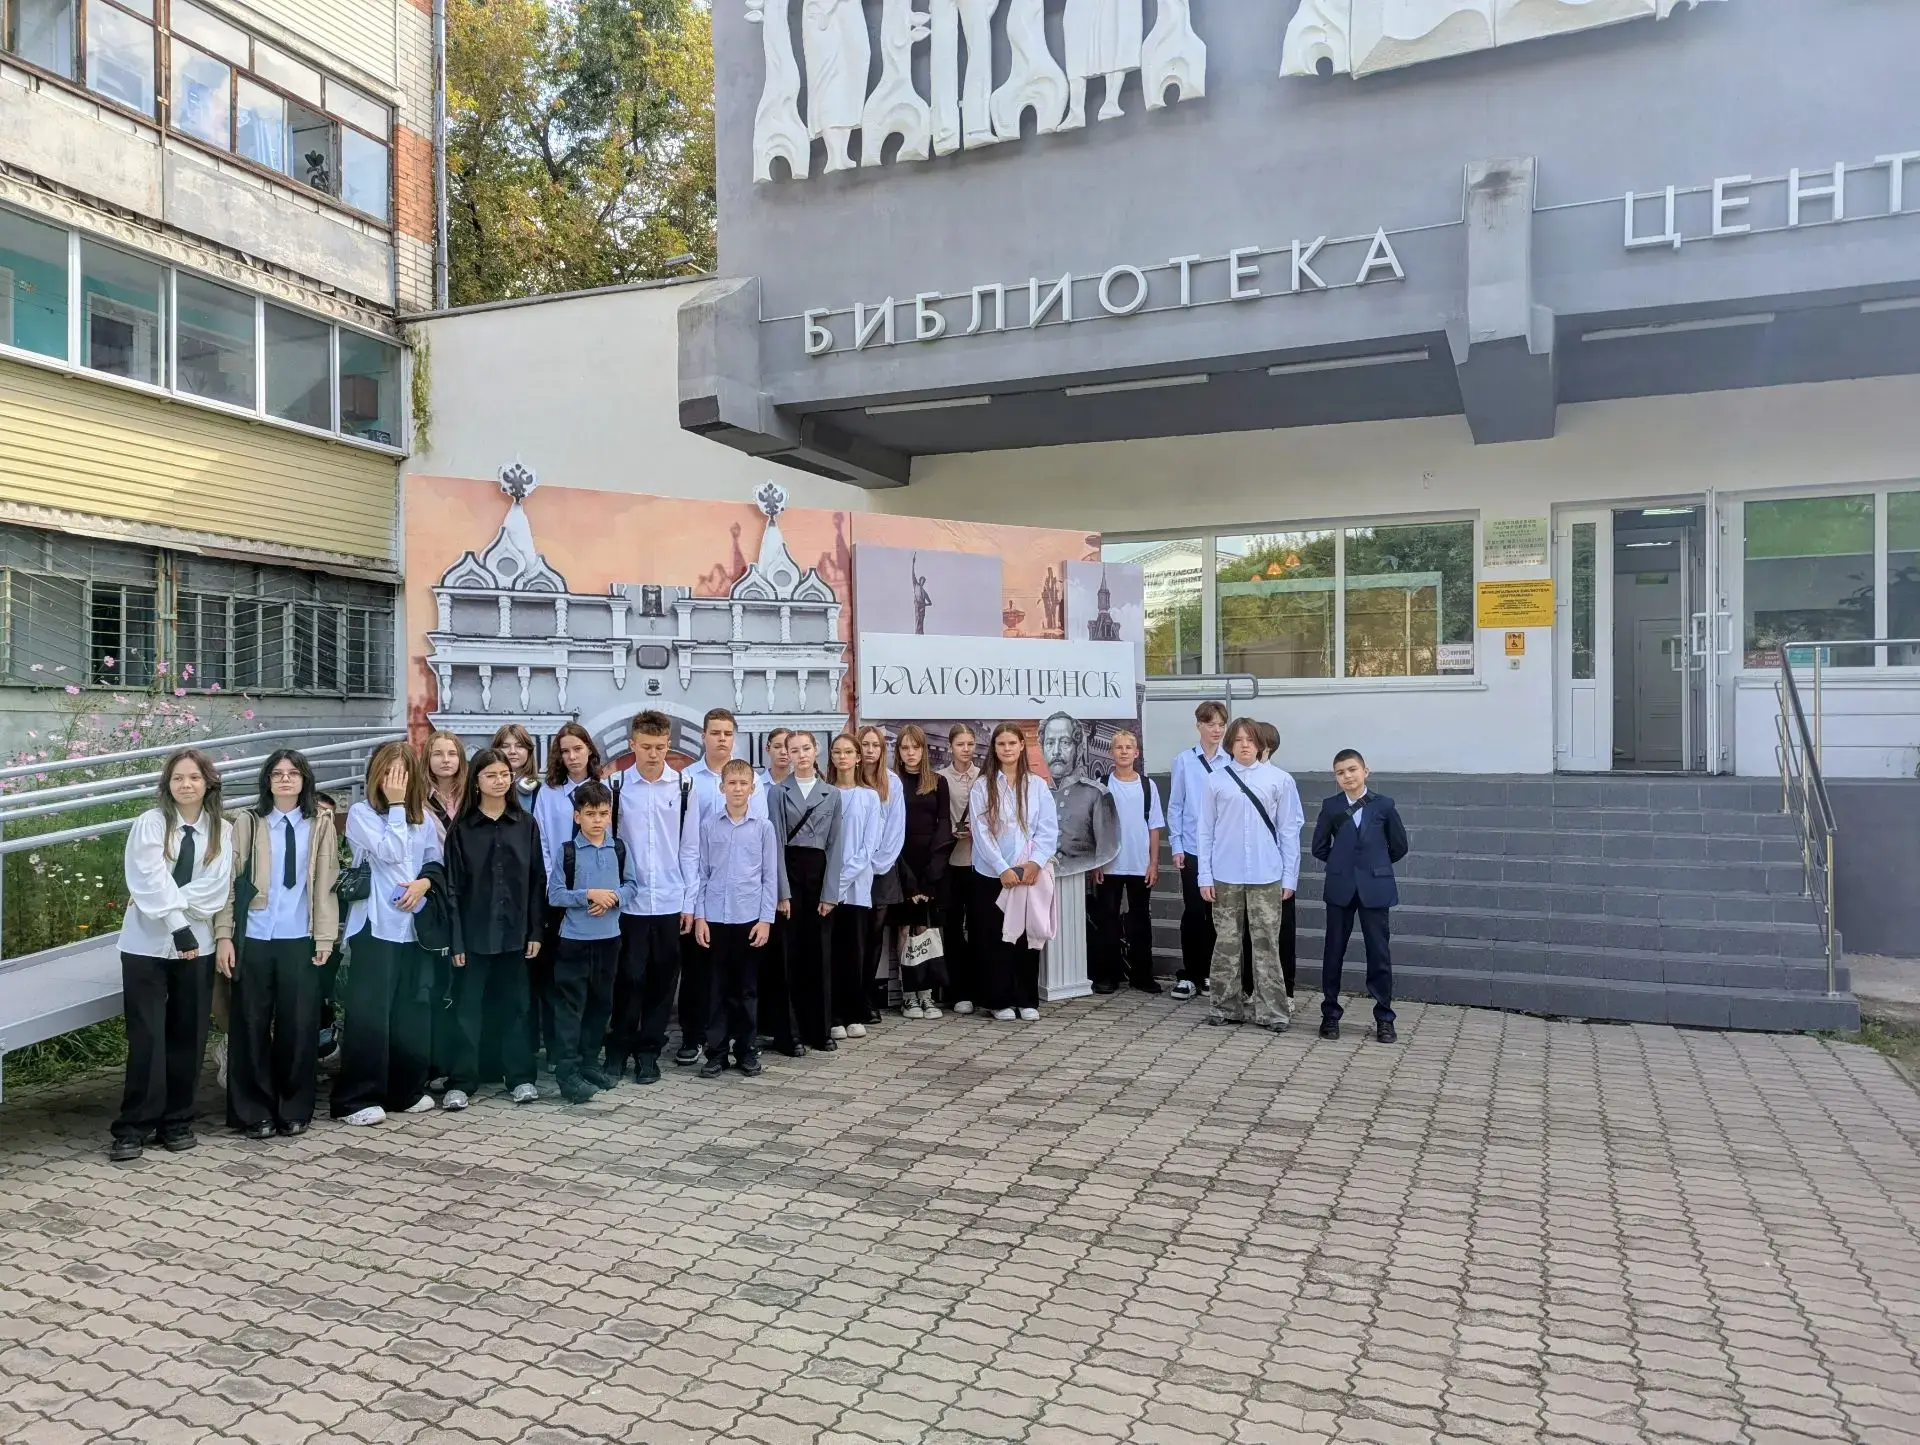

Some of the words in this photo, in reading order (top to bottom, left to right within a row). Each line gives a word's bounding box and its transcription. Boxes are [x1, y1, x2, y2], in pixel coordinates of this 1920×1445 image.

[1624, 151, 1920, 249] ЦЕНТ
[804, 226, 1405, 355] БИБЛИОТЕКА
[869, 665, 1122, 704] БЛАГОВЕЩЕНСК
